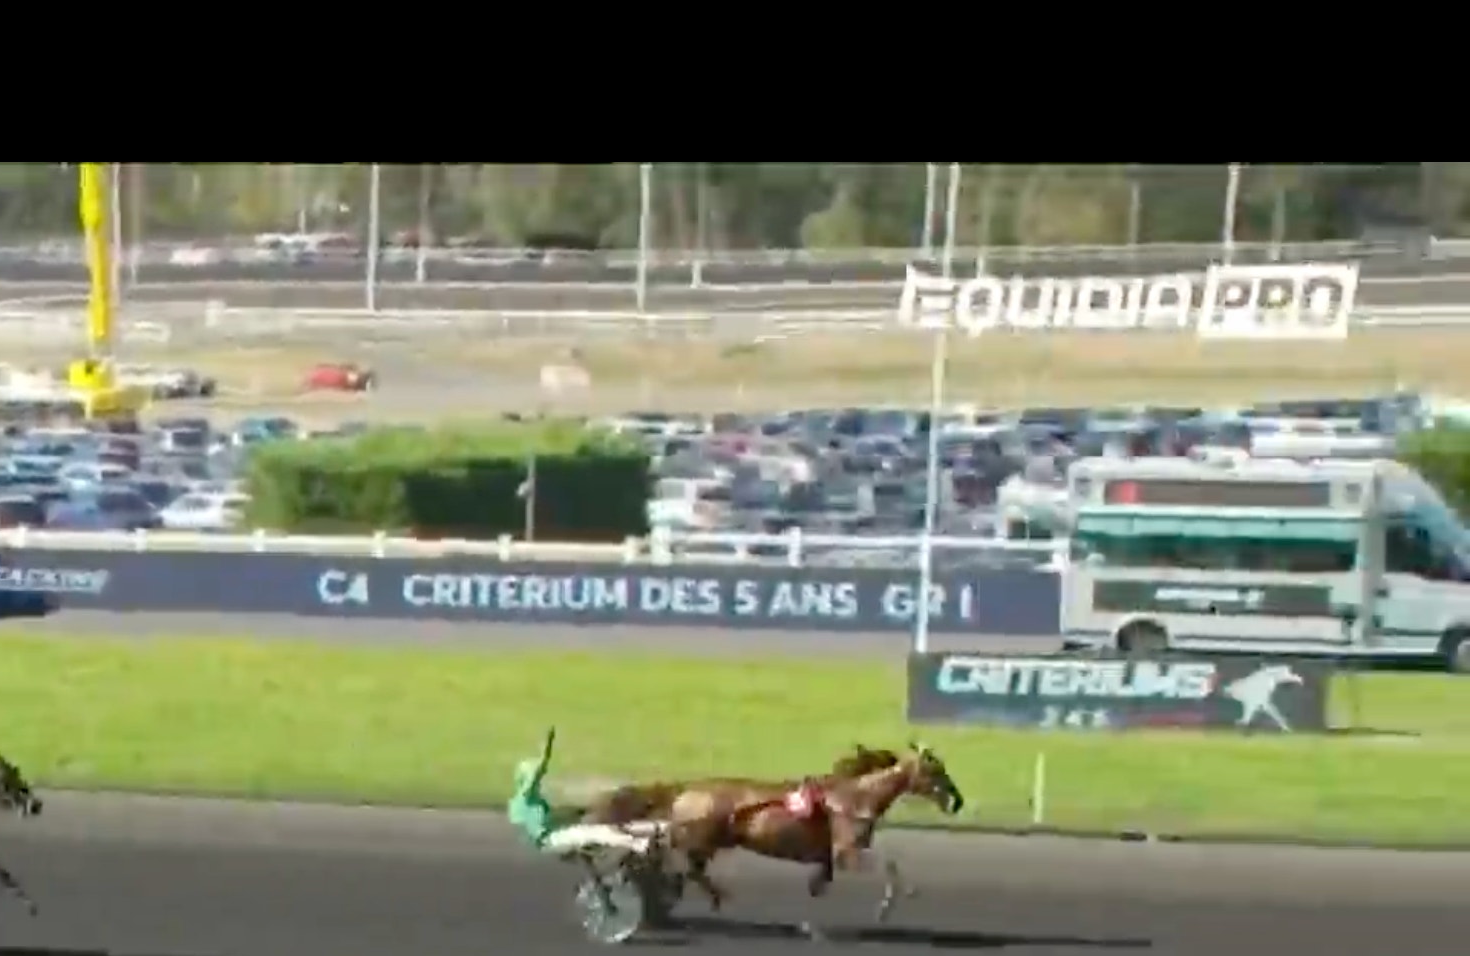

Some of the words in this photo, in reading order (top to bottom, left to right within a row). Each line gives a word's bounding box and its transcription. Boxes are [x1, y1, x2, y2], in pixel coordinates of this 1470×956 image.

[403, 573, 628, 611] CRITERIUM
[640, 577, 721, 614] DES
[769, 581, 859, 619] ANS
